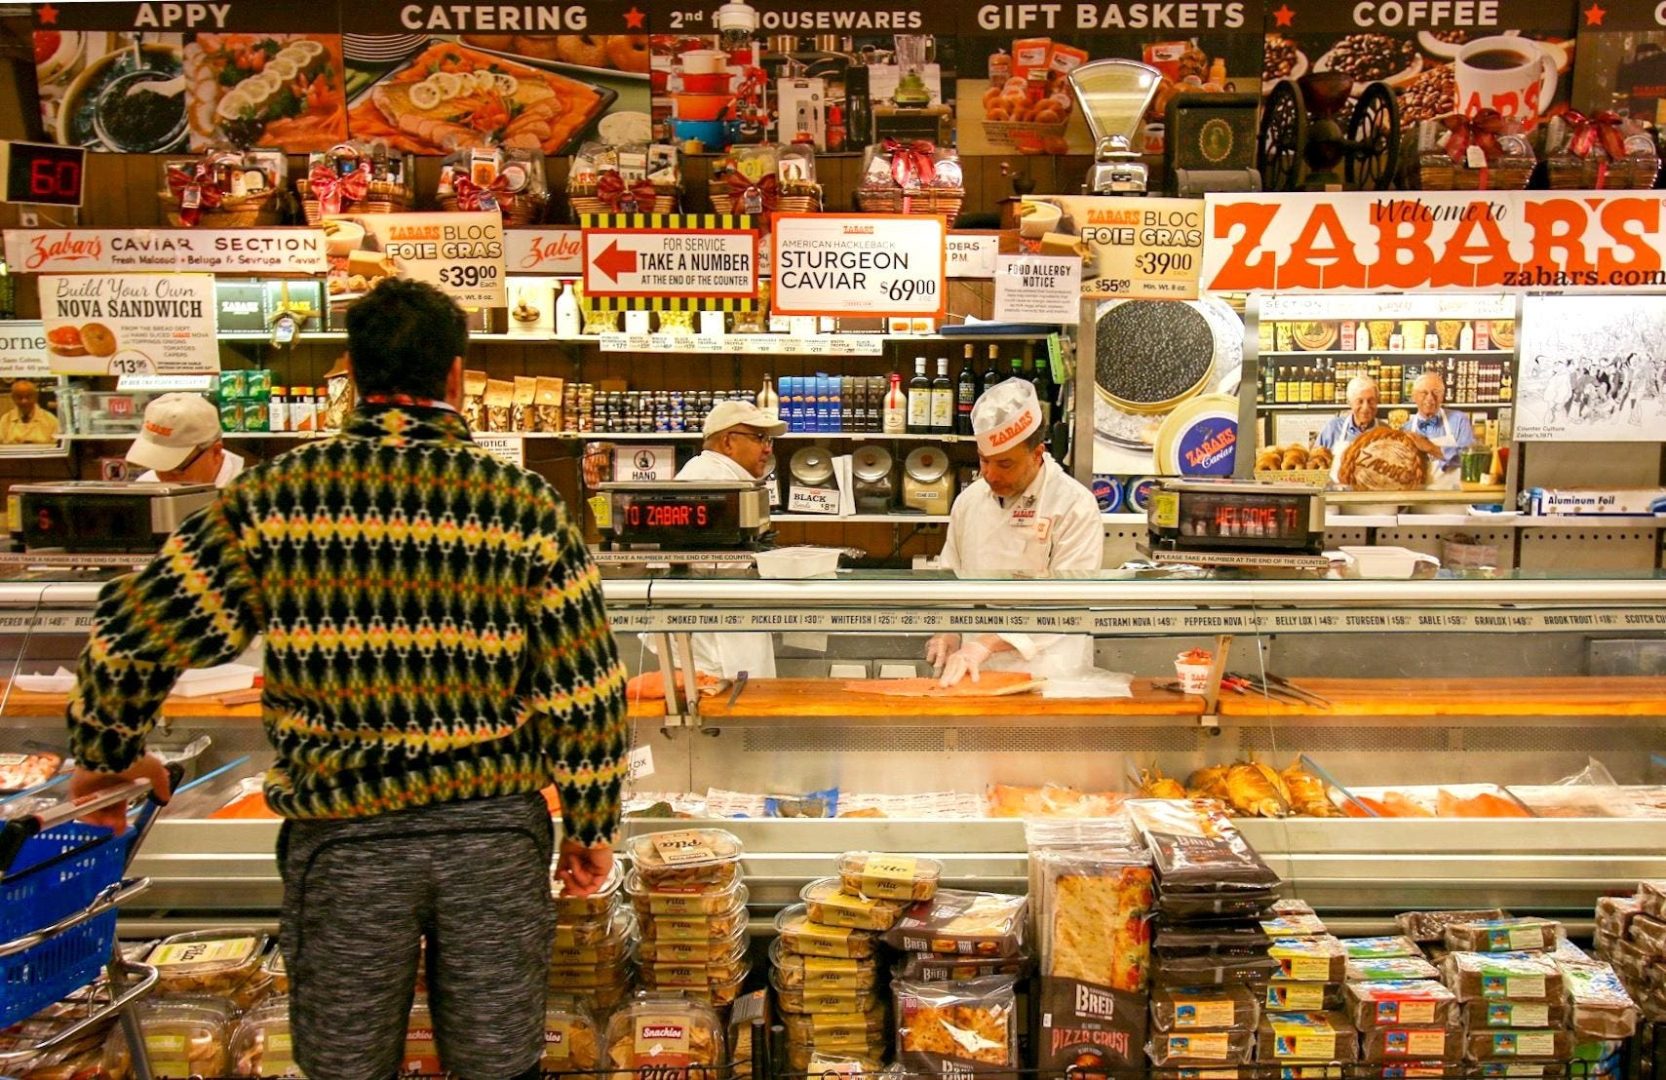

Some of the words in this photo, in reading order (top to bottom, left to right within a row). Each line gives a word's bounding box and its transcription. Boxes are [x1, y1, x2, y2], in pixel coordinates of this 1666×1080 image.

[134, 4, 231, 27] APPY
[401, 4, 588, 30] CATERING
[670, 11, 703, 29] 2nd
[978, 5, 1068, 29] GIFT
[1077, 1, 1244, 28] BASKETS
[1353, 1, 1497, 26] COFFEE
[31, 160, 79, 196] 60
[1087, 209, 1140, 225] ZABARS
[1144, 211, 1198, 227] BLOC
[1376, 198, 1477, 223] Welcome
[1484, 200, 1508, 222] to
[390, 226, 440, 241] ZABARS
[445, 225, 497, 240] BLOC
[1081, 227, 1135, 245] FOIE
[1140, 228, 1202, 247] GRAS
[25, 232, 103, 269] Zabar's
[111, 237, 194, 251] CAVIAR
[215, 237, 317, 251] SECTION
[385, 242, 437, 260] FOIE
[442, 242, 502, 260] GRAS
[520, 233, 582, 269] Zaba
[663, 237, 682, 251] FOR
[685, 238, 726, 252] SERVICE
[782, 240, 832, 249] AMERICAN
[834, 240, 896, 249] HACKLEBACK
[946, 242, 980, 251] DERS
[1208, 198, 1662, 291] ZABAR'S
[112, 255, 136, 264] Fresh
[187, 255, 222, 267] Beluga
[238, 255, 282, 267] Sevruga
[289, 255, 321, 264] Caviar
[640, 253, 674, 271] TAKE
[678, 253, 687, 271] A
[691, 253, 749, 271] NUMBER
[781, 250, 909, 270] STURGEON
[1008, 264, 1031, 275] FOOD
[1033, 265, 1071, 276] ALLERGY
[1503, 266, 1666, 286] zabars.com
[641, 275, 650, 284] AT
[652, 275, 666, 285] THE
[668, 275, 683, 285] END
[686, 275, 696, 285] OF
[698, 275, 711, 285] THE
[713, 275, 748, 286] COUNTER
[781, 271, 866, 290] CAVIAR
[1022, 276, 1055, 288] NOTICE
[56, 278, 103, 298] Build
[107, 278, 150, 300] Your
[155, 279, 196, 298] Own
[58, 299, 103, 317] NOVA
[107, 300, 203, 318] SANDWICH
[989, 410, 1033, 447] ZABARS
[478, 440, 507, 448] NOTICE
[1185, 427, 1237, 467] ZABARS
[1200, 445, 1233, 469] Caviar
[632, 471, 656, 480] HAND
[794, 493, 827, 503] BLACK
[1548, 496, 1595, 505] Aluminum
[1598, 495, 1615, 505] Foil
[623, 505, 640, 526] TO
[1216, 506, 1276, 528] WELCOME
[75, 617, 96, 626] BELL
[667, 615, 697, 625] SMOKED
[699, 615, 719, 625] TUNA
[751, 615, 782, 624] PICKLED
[784, 615, 798, 624] LOX
[831, 615, 872, 624] WHITEFISH
[950, 616, 973, 624] BAKED
[975, 616, 1004, 625] SALMON
[1037, 617, 1056, 626] NOVA
[1094, 617, 1131, 627] PASTRAMI
[1133, 617, 1151, 626] NOVA
[1184, 617, 1222, 626] PEPPERED
[1223, 617, 1243, 626] NOVA
[1275, 616, 1296, 625] BELLY
[1298, 616, 1312, 625] LOX
[1346, 616, 1385, 625] STURGEON
[1419, 616, 1441, 625] SABLE
[1474, 616, 1506, 625] GRAVLOX
[1544, 616, 1568, 625] BROOK
[1569, 615, 1592, 624] TROUT
[1625, 614, 1655, 624] SCOTCH
[630, 759, 647, 769] OX
[875, 881, 899, 890] Pita
[903, 936, 927, 951] BRED
[923, 967, 947, 981] BRED
[1075, 983, 1114, 1015] BRED
[1051, 1028, 1090, 1057] PIZZA
[1092, 1030, 1129, 1060] CRUST
